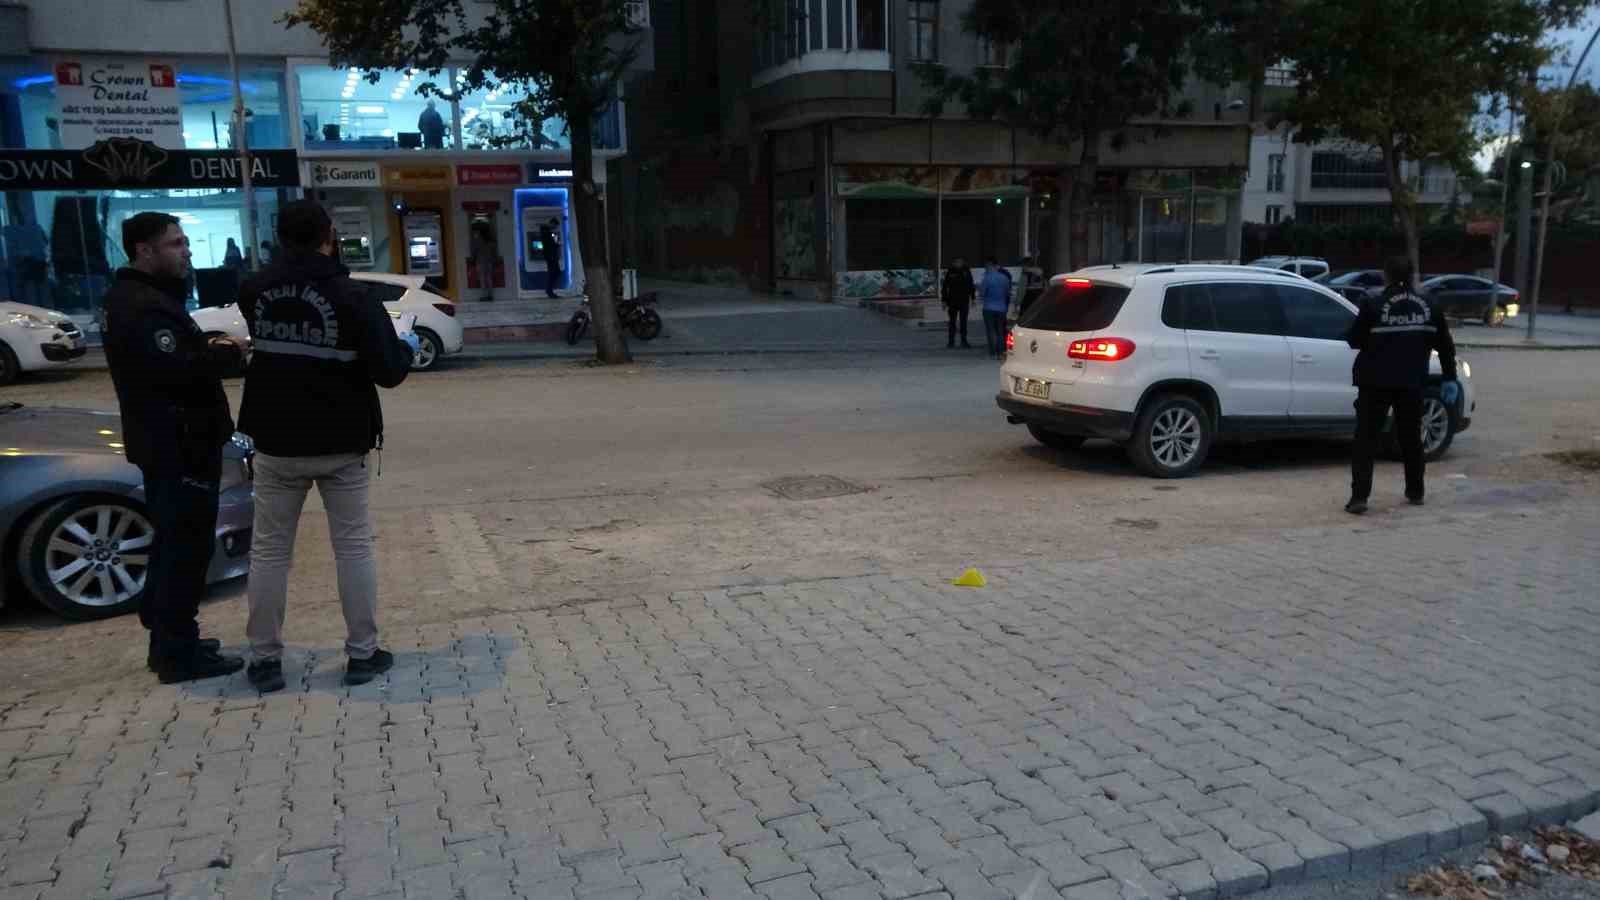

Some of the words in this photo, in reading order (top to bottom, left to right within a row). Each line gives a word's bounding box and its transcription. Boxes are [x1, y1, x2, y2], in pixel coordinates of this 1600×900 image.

[90, 69, 144, 85] Crown
[88, 85, 149, 101] Dental
[190, 157, 280, 179] DENAL
[329, 167, 376, 180] Garanti
